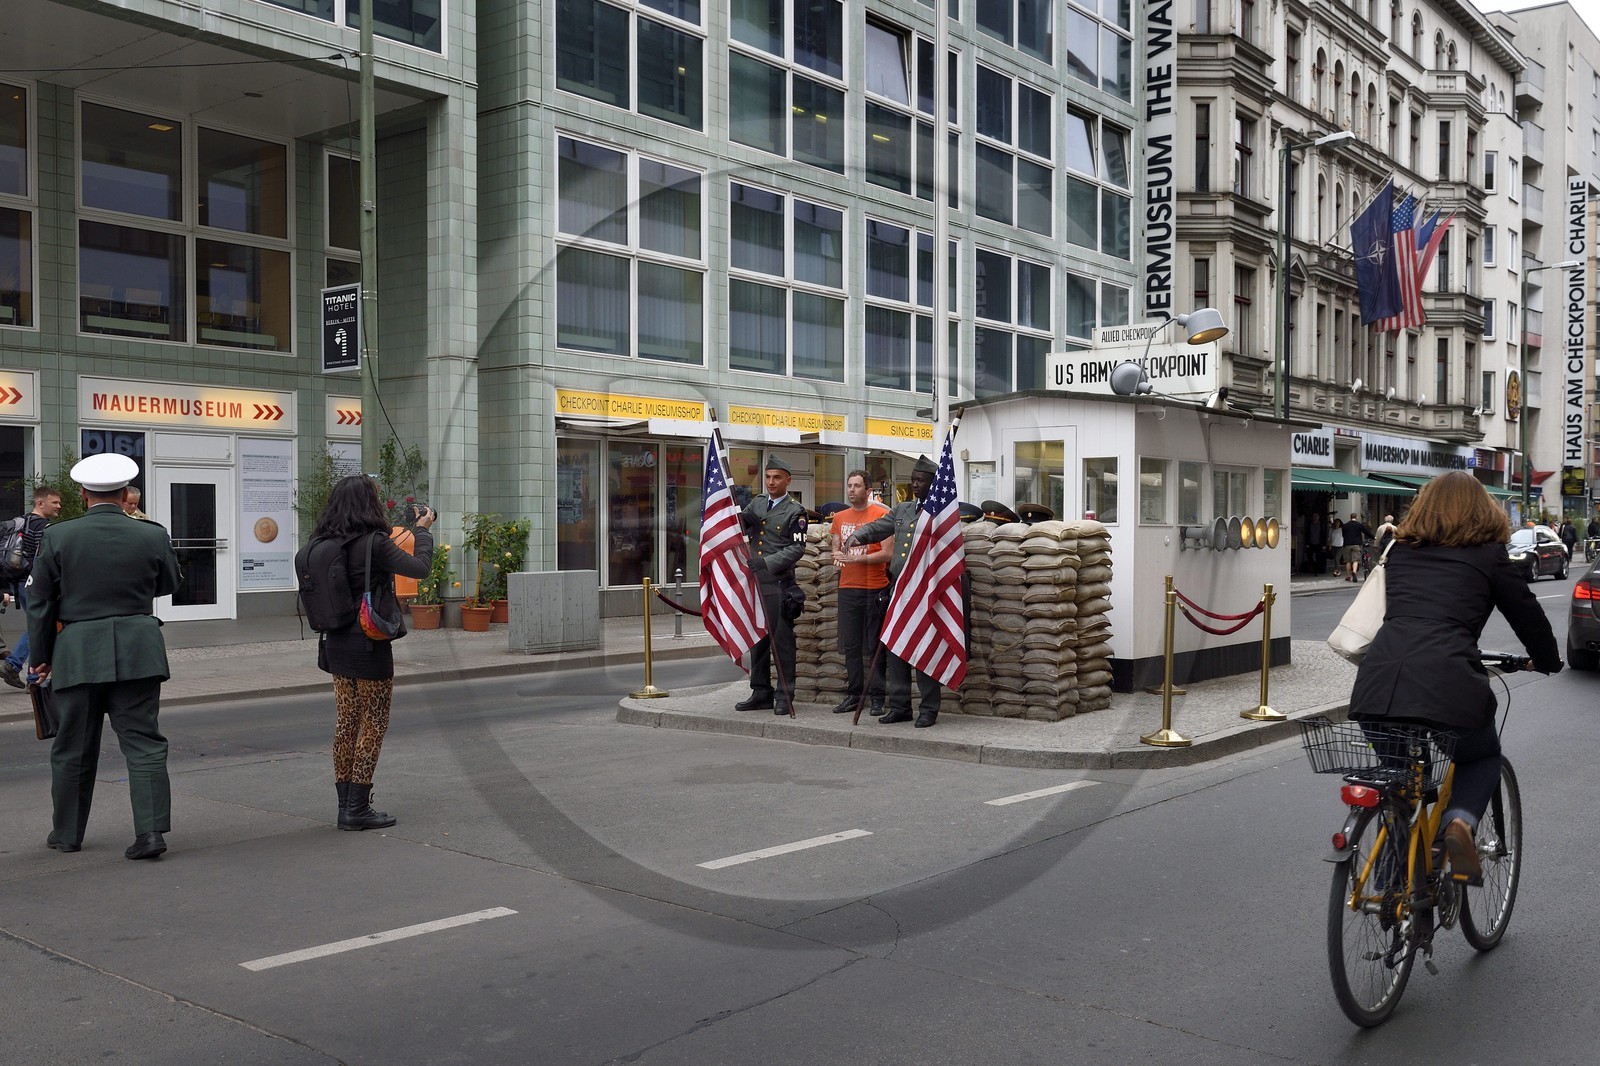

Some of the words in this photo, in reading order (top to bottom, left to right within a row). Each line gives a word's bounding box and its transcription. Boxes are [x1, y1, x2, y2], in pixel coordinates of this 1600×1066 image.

[1147, 0, 1173, 59] WA
[1147, 64, 1172, 122] THE
[1569, 181, 1586, 254] CHARLIE
[325, 293, 356, 305] TITANIC
[328, 302, 354, 312] HOTEL
[1101, 329, 1120, 343] ALLIED
[1121, 326, 1158, 342] CHECKPOINT
[1080, 359, 1118, 383] ARMY
[1567, 379, 1583, 408] AM
[92, 393, 242, 419] MAUERMUSEUM
[560, 395, 610, 412] CHECKPOINT
[611, 400, 643, 415] CHARLIE
[645, 403, 701, 419] MUSEUMSSHOP
[731, 411, 771, 425] CHECKPOINT
[771, 414, 796, 427] CHARLIE
[798, 417, 843, 430] MUSEUMSSHOP
[890, 425, 914, 437] SINCE
[1293, 433, 1330, 456] CHARLIE
[1566, 413, 1582, 460] HAUS
[1365, 443, 1410, 465] MAUERSHOP
[1411, 449, 1420, 466] IM
